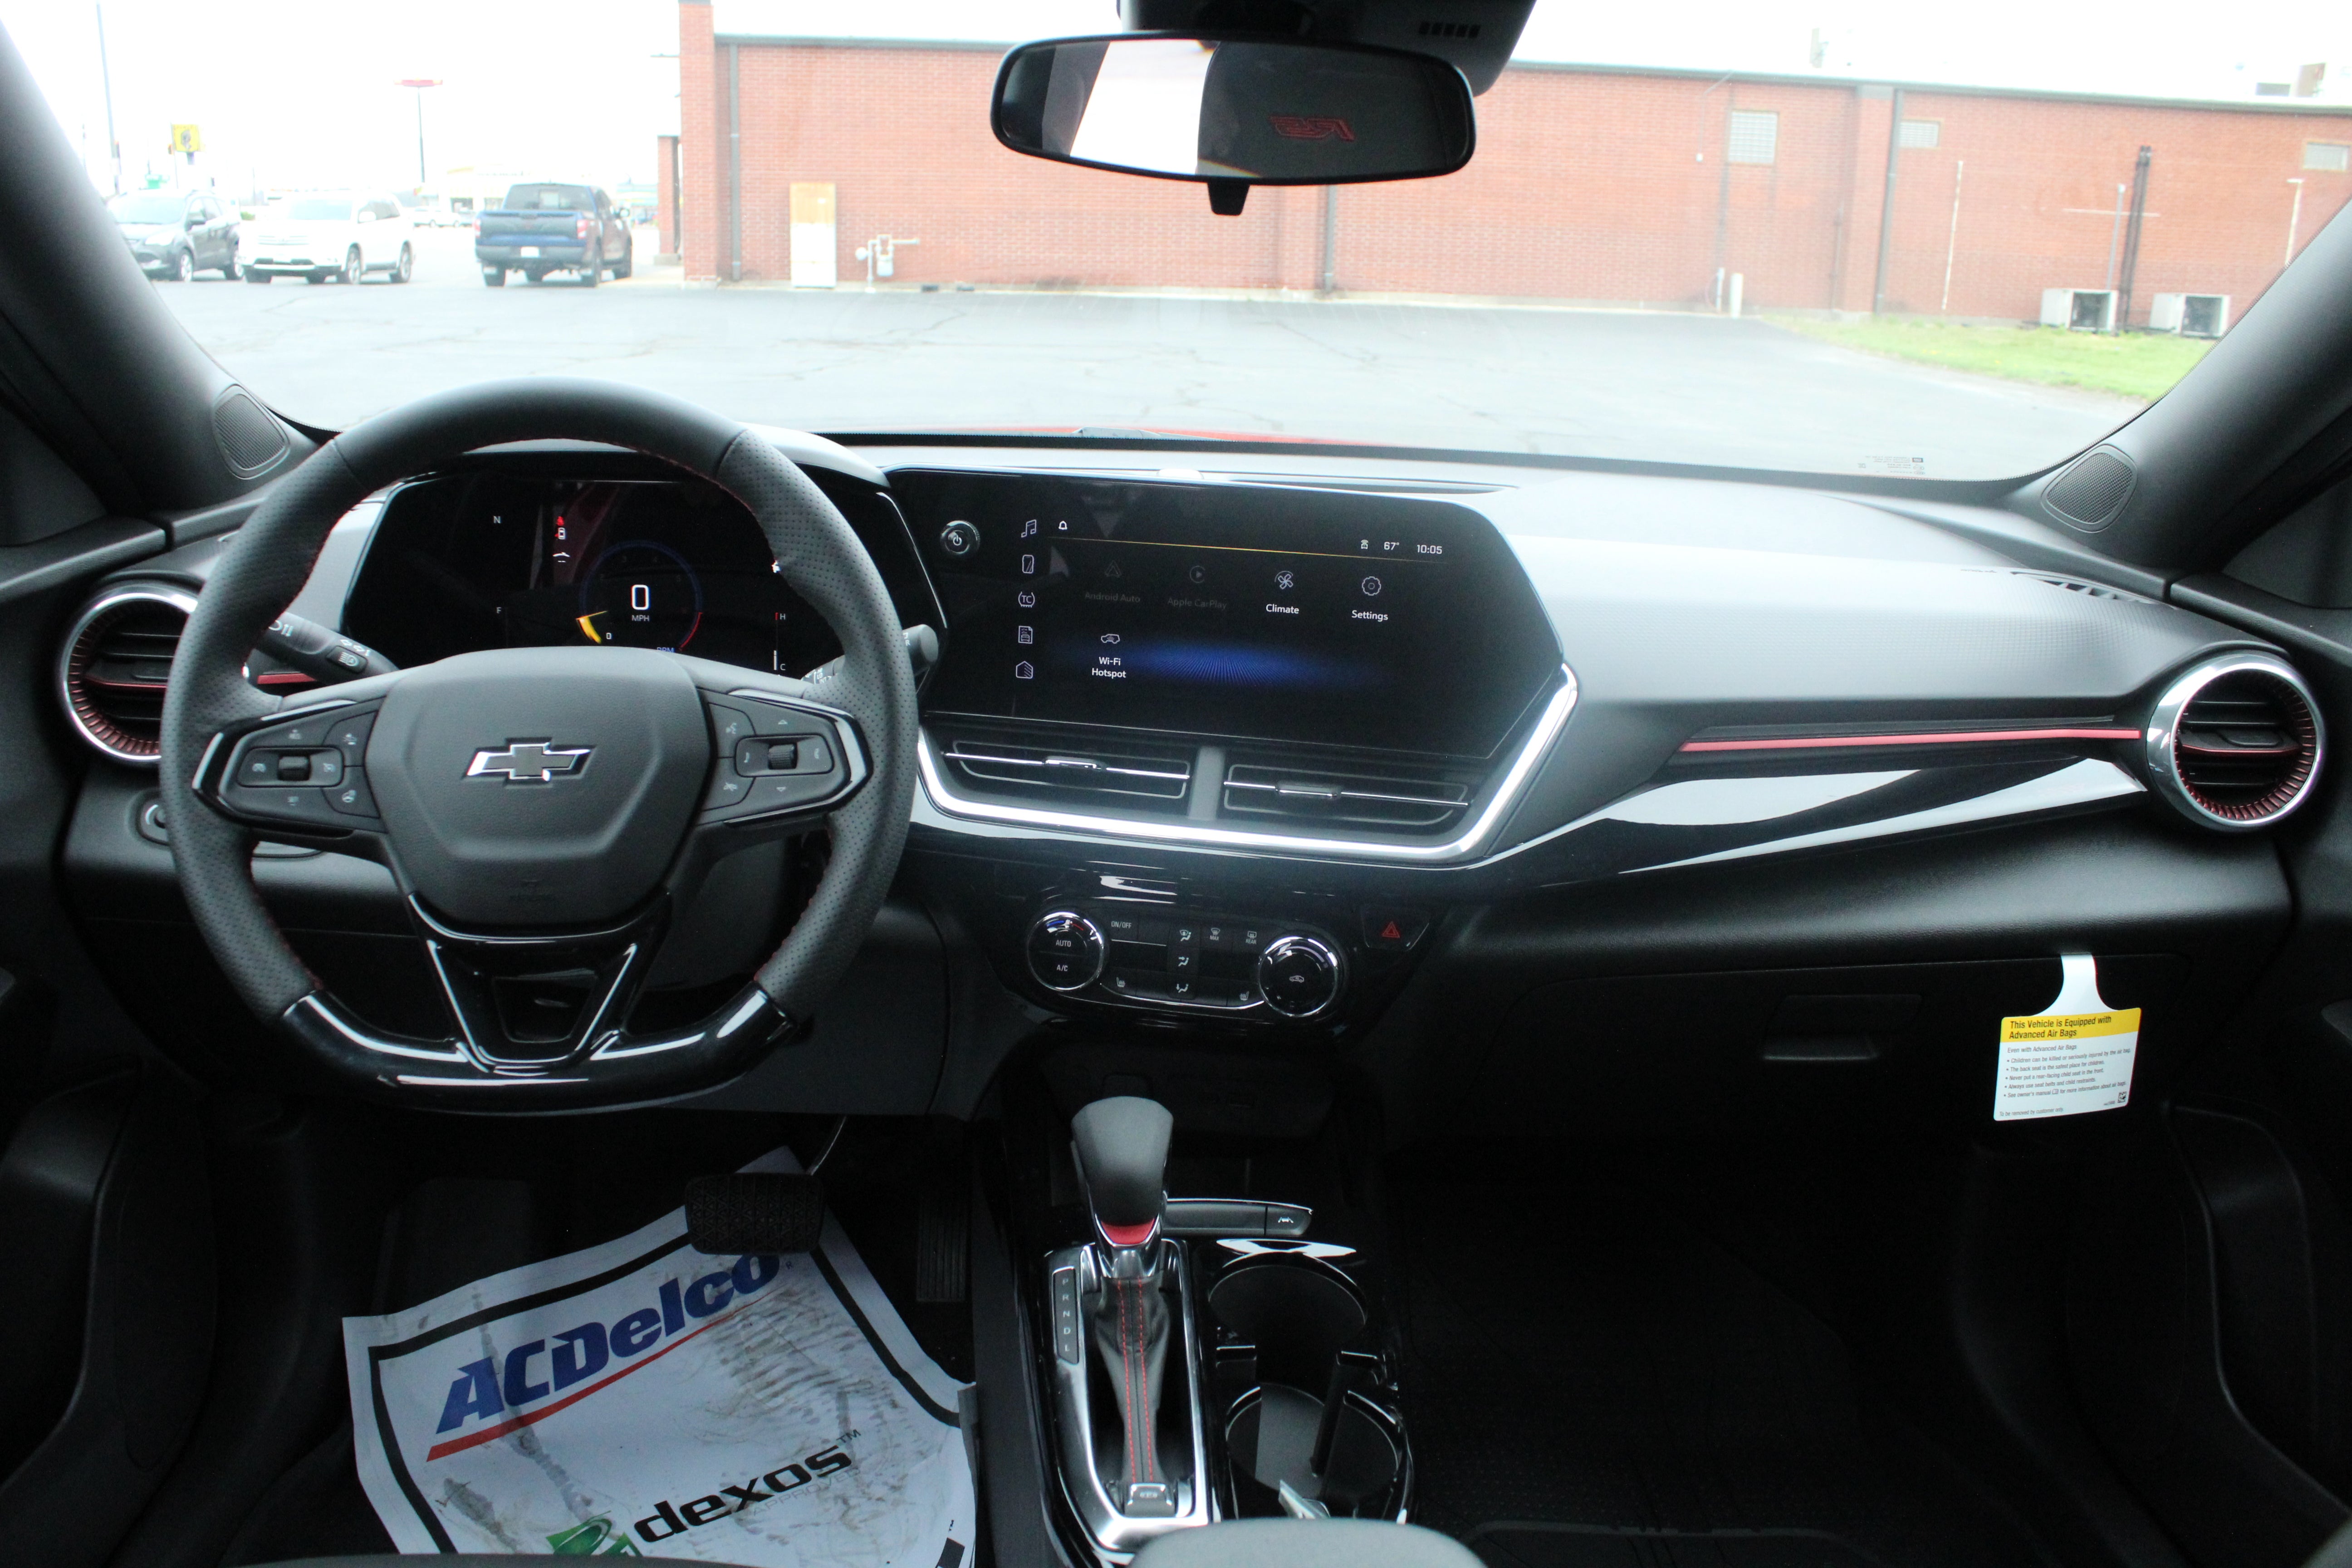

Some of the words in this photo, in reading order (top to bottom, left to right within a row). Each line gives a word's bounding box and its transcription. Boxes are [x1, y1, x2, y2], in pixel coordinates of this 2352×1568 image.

[1416, 544, 1442, 554] 10:05
[630, 584, 650, 611] 0
[1085, 591, 1118, 601] Android
[1120, 594, 1141, 603] Auto
[1167, 597, 1192, 607] Apple
[1194, 599, 1227, 610] CarPlay
[1266, 604, 1299, 614] Climate
[1352, 610, 1388, 622] Settings
[1098, 657, 1121, 666] Wi-Fi
[1092, 668, 1126, 679] Hotspot
[1111, 921, 1132, 929] ON/OFF
[1055, 939, 1072, 947] AUTO
[1056, 964, 1068, 972] A/C
[2028, 1019, 2054, 1028] Vehicle
[2064, 1017, 2096, 1028] Equipped
[2009, 1030, 2045, 1039] Advanced
[2060, 1029, 2077, 1038] Bags
[1063, 1327, 1071, 1335] D
[436, 1252, 780, 1434] ACDelco
[634, 1445, 852, 1543] dexos
[836, 1429, 862, 1444] TM
[753, 1468, 861, 1516] APPROVED
